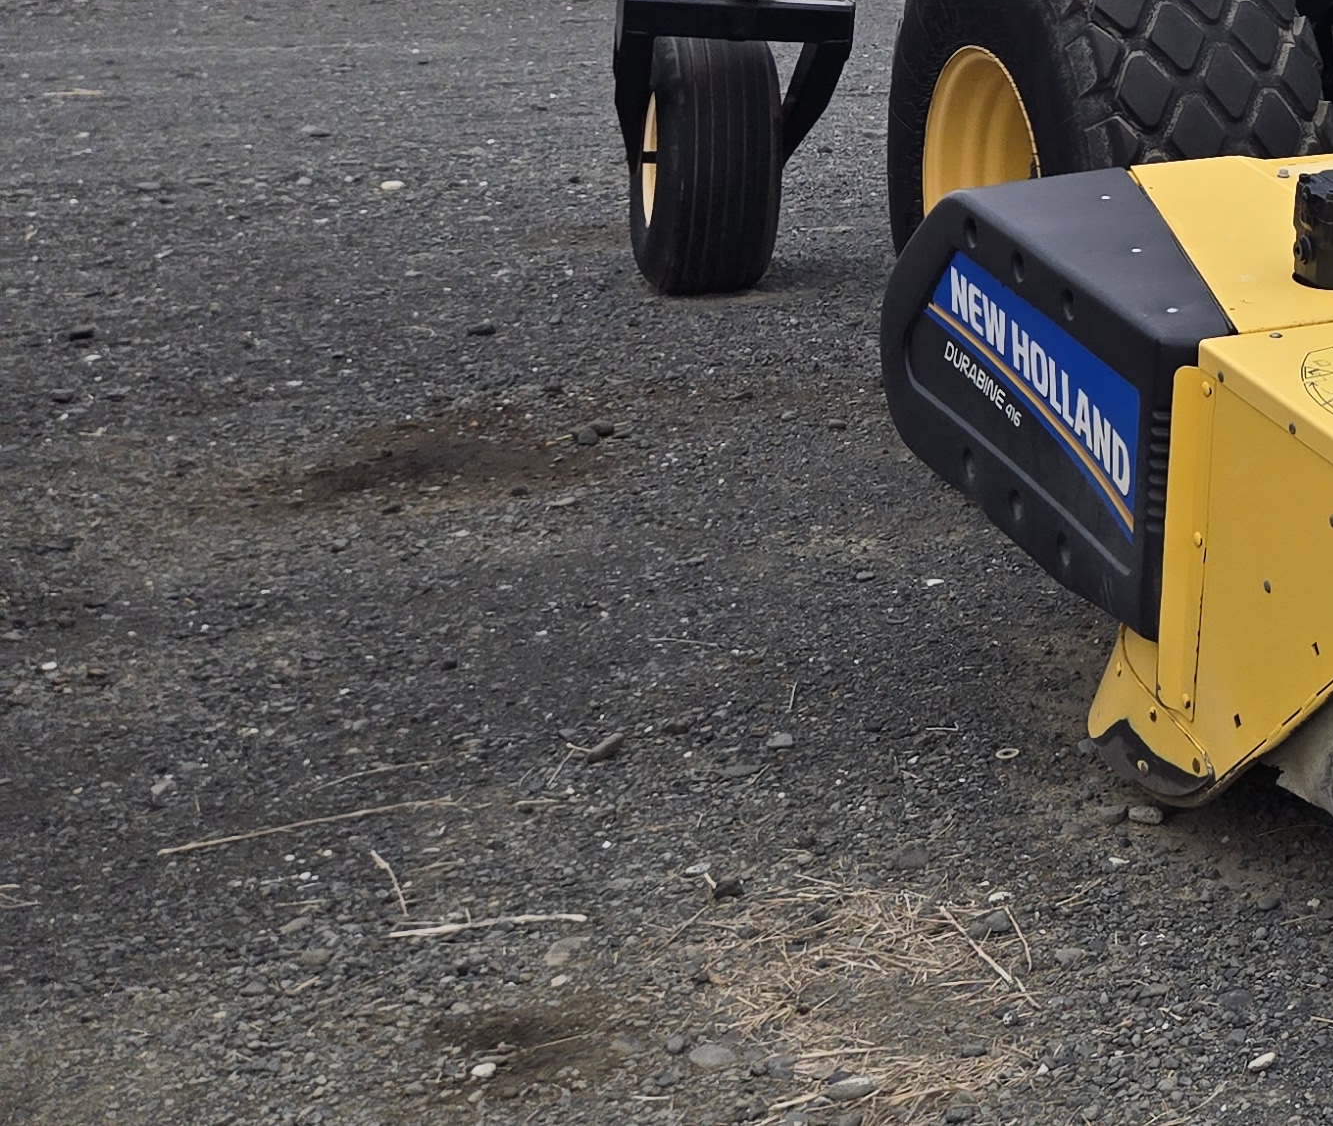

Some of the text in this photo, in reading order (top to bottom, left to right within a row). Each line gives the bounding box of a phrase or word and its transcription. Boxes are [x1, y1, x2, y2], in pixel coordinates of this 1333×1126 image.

[944, 340, 1022, 427] DURABINE 916
[951, 266, 1130, 496] NEW HOLLAND
